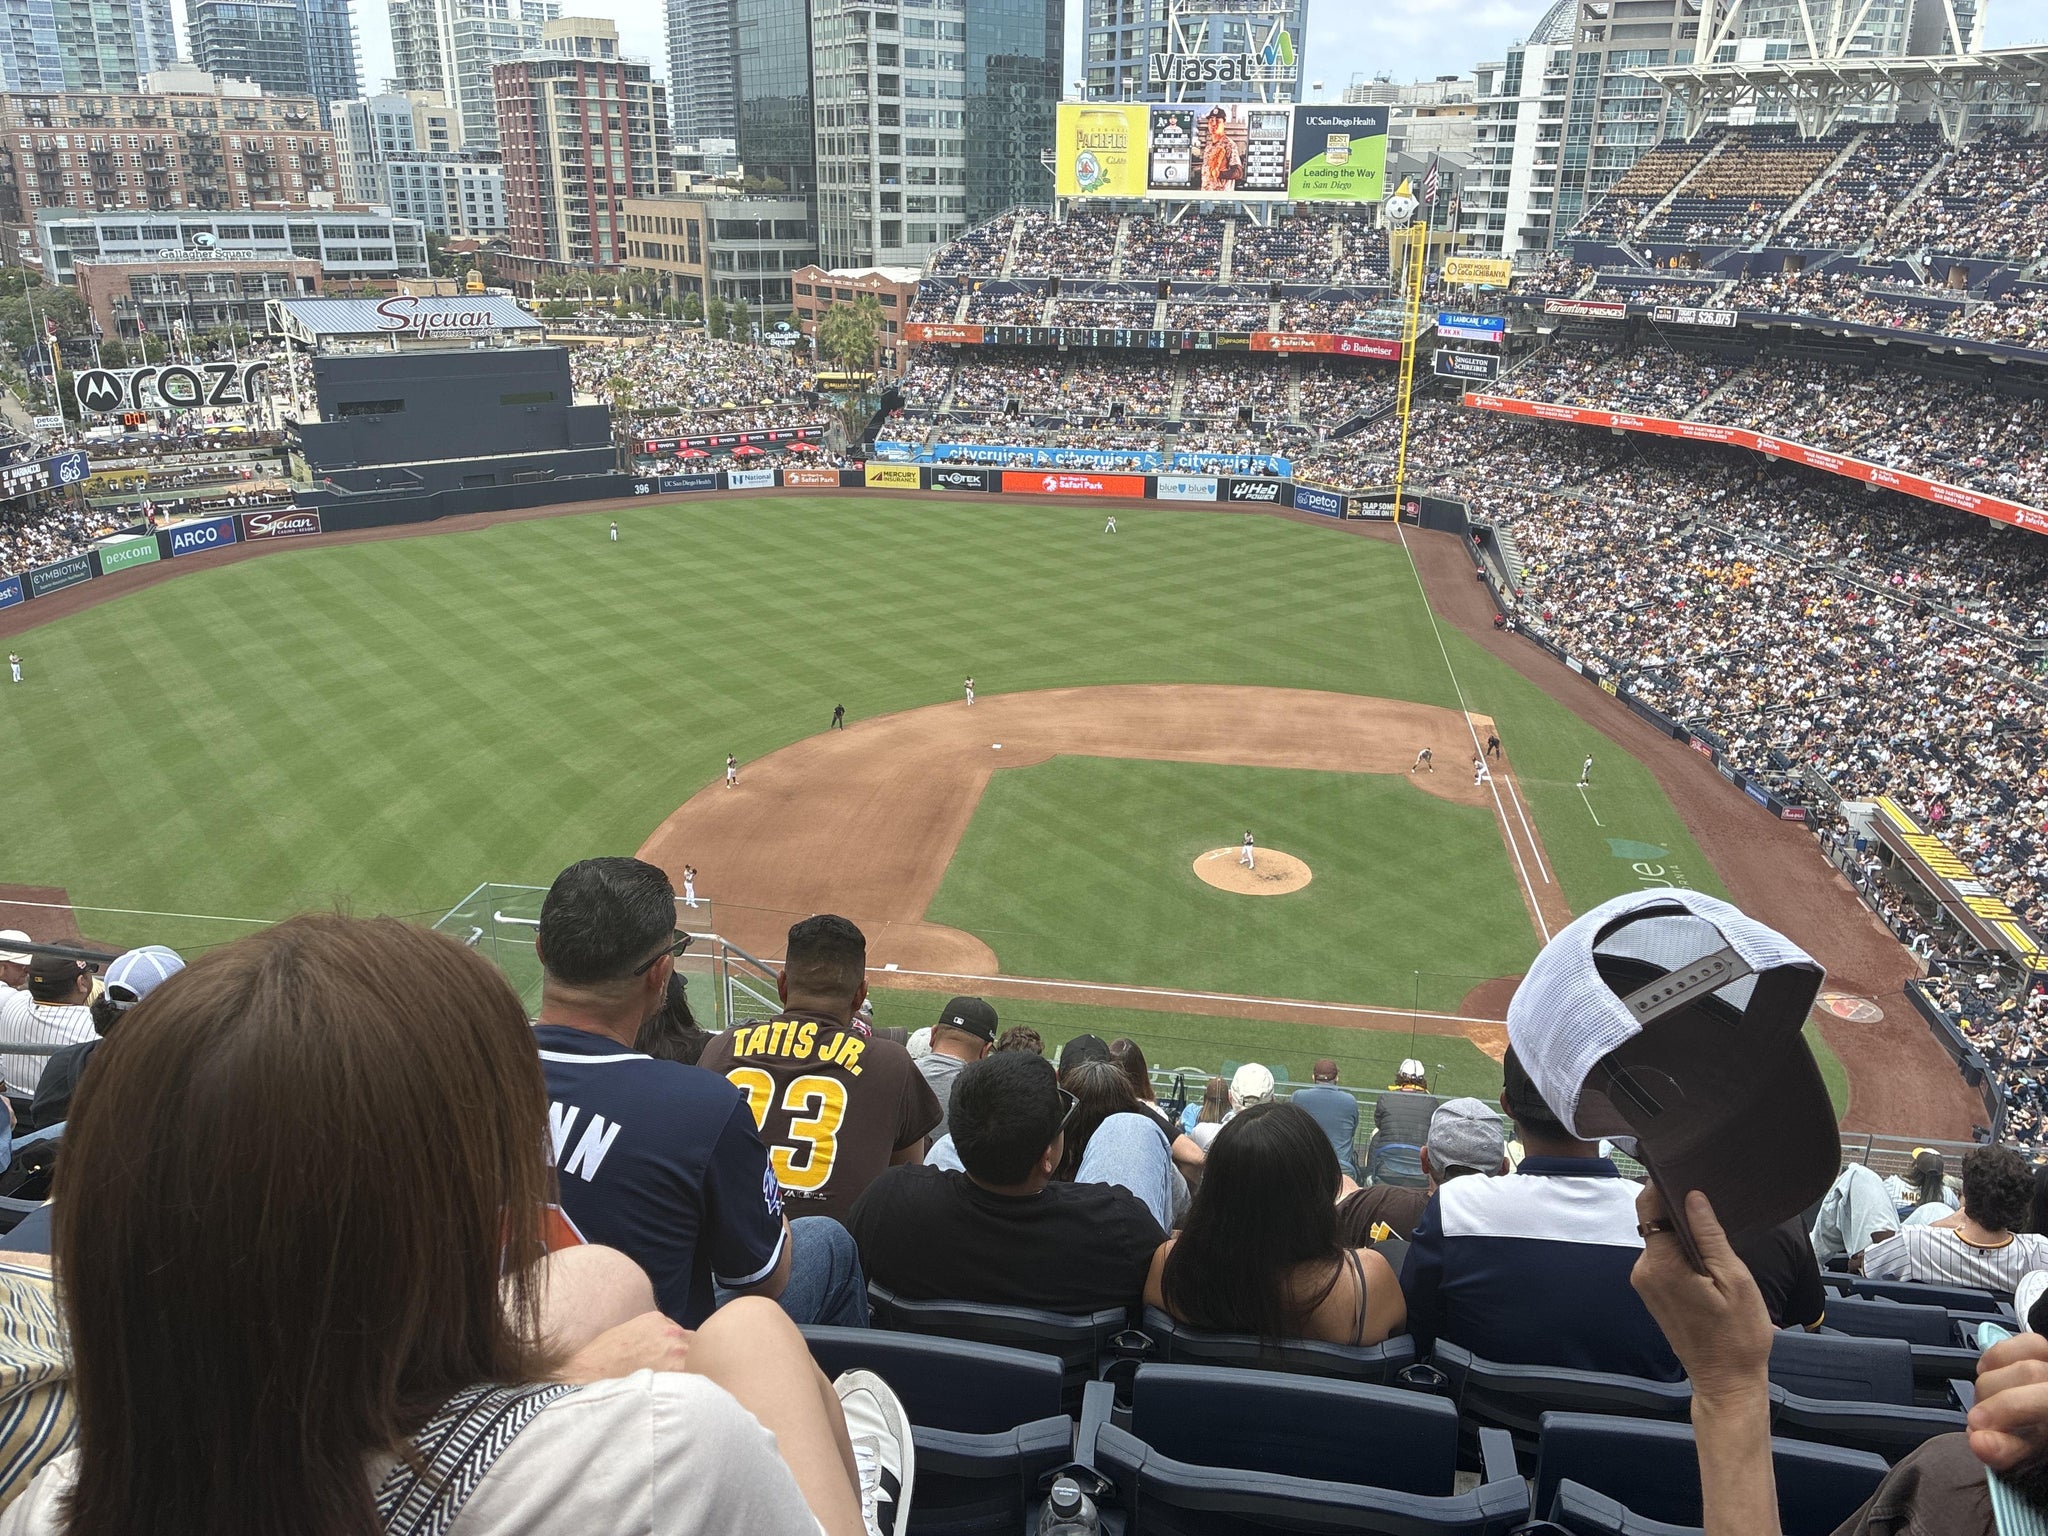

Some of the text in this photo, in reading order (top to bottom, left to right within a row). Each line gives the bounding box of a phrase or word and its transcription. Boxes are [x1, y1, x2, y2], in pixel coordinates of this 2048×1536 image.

[1155, 53, 1251, 81] Viasat
[1306, 117, 1376, 127] UC San Diego Health
[1304, 169, 1376, 179] Leading the Way
[1303, 181, 1352, 189] in San Diego
[159, 248, 253, 260] Gallagher Square
[1473, 270, 1506, 278] ICHIBANYA
[1546, 301, 1623, 317] Tarantino SAUSAGES
[375, 295, 497, 340] Sycuan
[1698, 311, 1732, 325] $26,075
[765, 331, 800, 340] Gallagher
[994, 327, 998, 335] 4
[1026, 327, 1031, 335] 3
[1059, 328, 1064, 336] 2
[1092, 329, 1097, 338] 6
[1126, 330, 1131, 339] 0
[1160, 330, 1165, 339] 6
[770, 339, 796, 347] Square
[994, 335, 998, 343] 1
[1026, 336, 1031, 344] 5
[1092, 338, 1098, 346] 5
[1126, 339, 1131, 347] 2
[1160, 339, 1165, 348] 8
[1353, 342, 1393, 356] Budweiser
[1454, 355, 1489, 366] SINGLETON
[1453, 362, 1488, 373] SCHREIBER
[129, 361, 270, 410] razr
[37, 416, 59, 424] petco
[745, 473, 771, 481] National
[938, 472, 981, 484] EVOTEK
[683, 479, 695, 487] Diego
[695, 478, 712, 486] Health
[634, 483, 650, 495] 396
[1159, 483, 1207, 492] blue blue
[1248, 483, 1278, 494] H2O
[1309, 495, 1337, 508] petco
[250, 514, 313, 536] Sycuan
[174, 527, 218, 549] ARCO
[33, 561, 88, 585] CYMBIOTIKA
[733, 1021, 866, 1077] TATIS JR.
